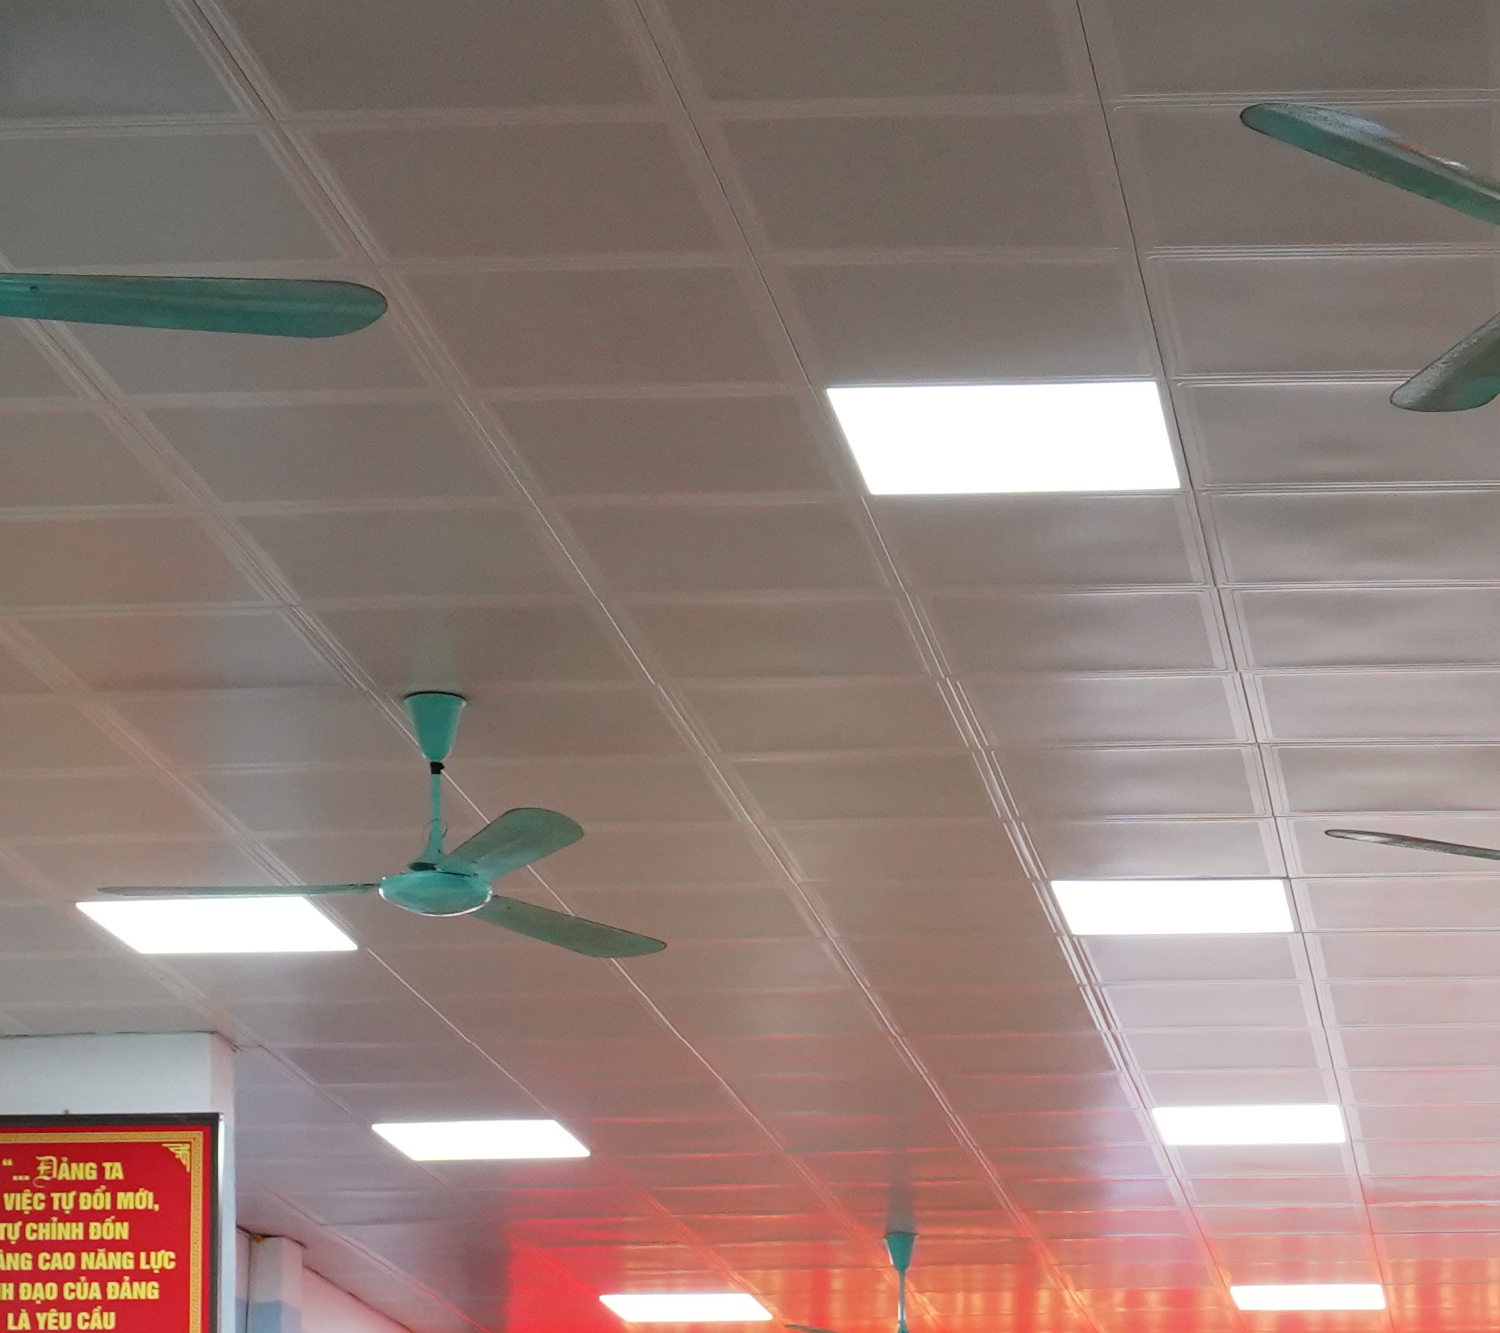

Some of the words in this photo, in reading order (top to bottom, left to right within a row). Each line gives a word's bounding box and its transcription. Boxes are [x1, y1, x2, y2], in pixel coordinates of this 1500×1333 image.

[32, 1155, 97, 1188] ĐẢNG
[102, 1162, 124, 1180] TA
[38, 1252, 75, 1270] CAO
[81, 1249, 134, 1270] NĂNG
[140, 1250, 176, 1273] LỰC
[19, 1282, 58, 1304] ĐẠO
[63, 1278, 102, 1300] CỦA
[106, 1278, 159, 1299] ĐẢNG
